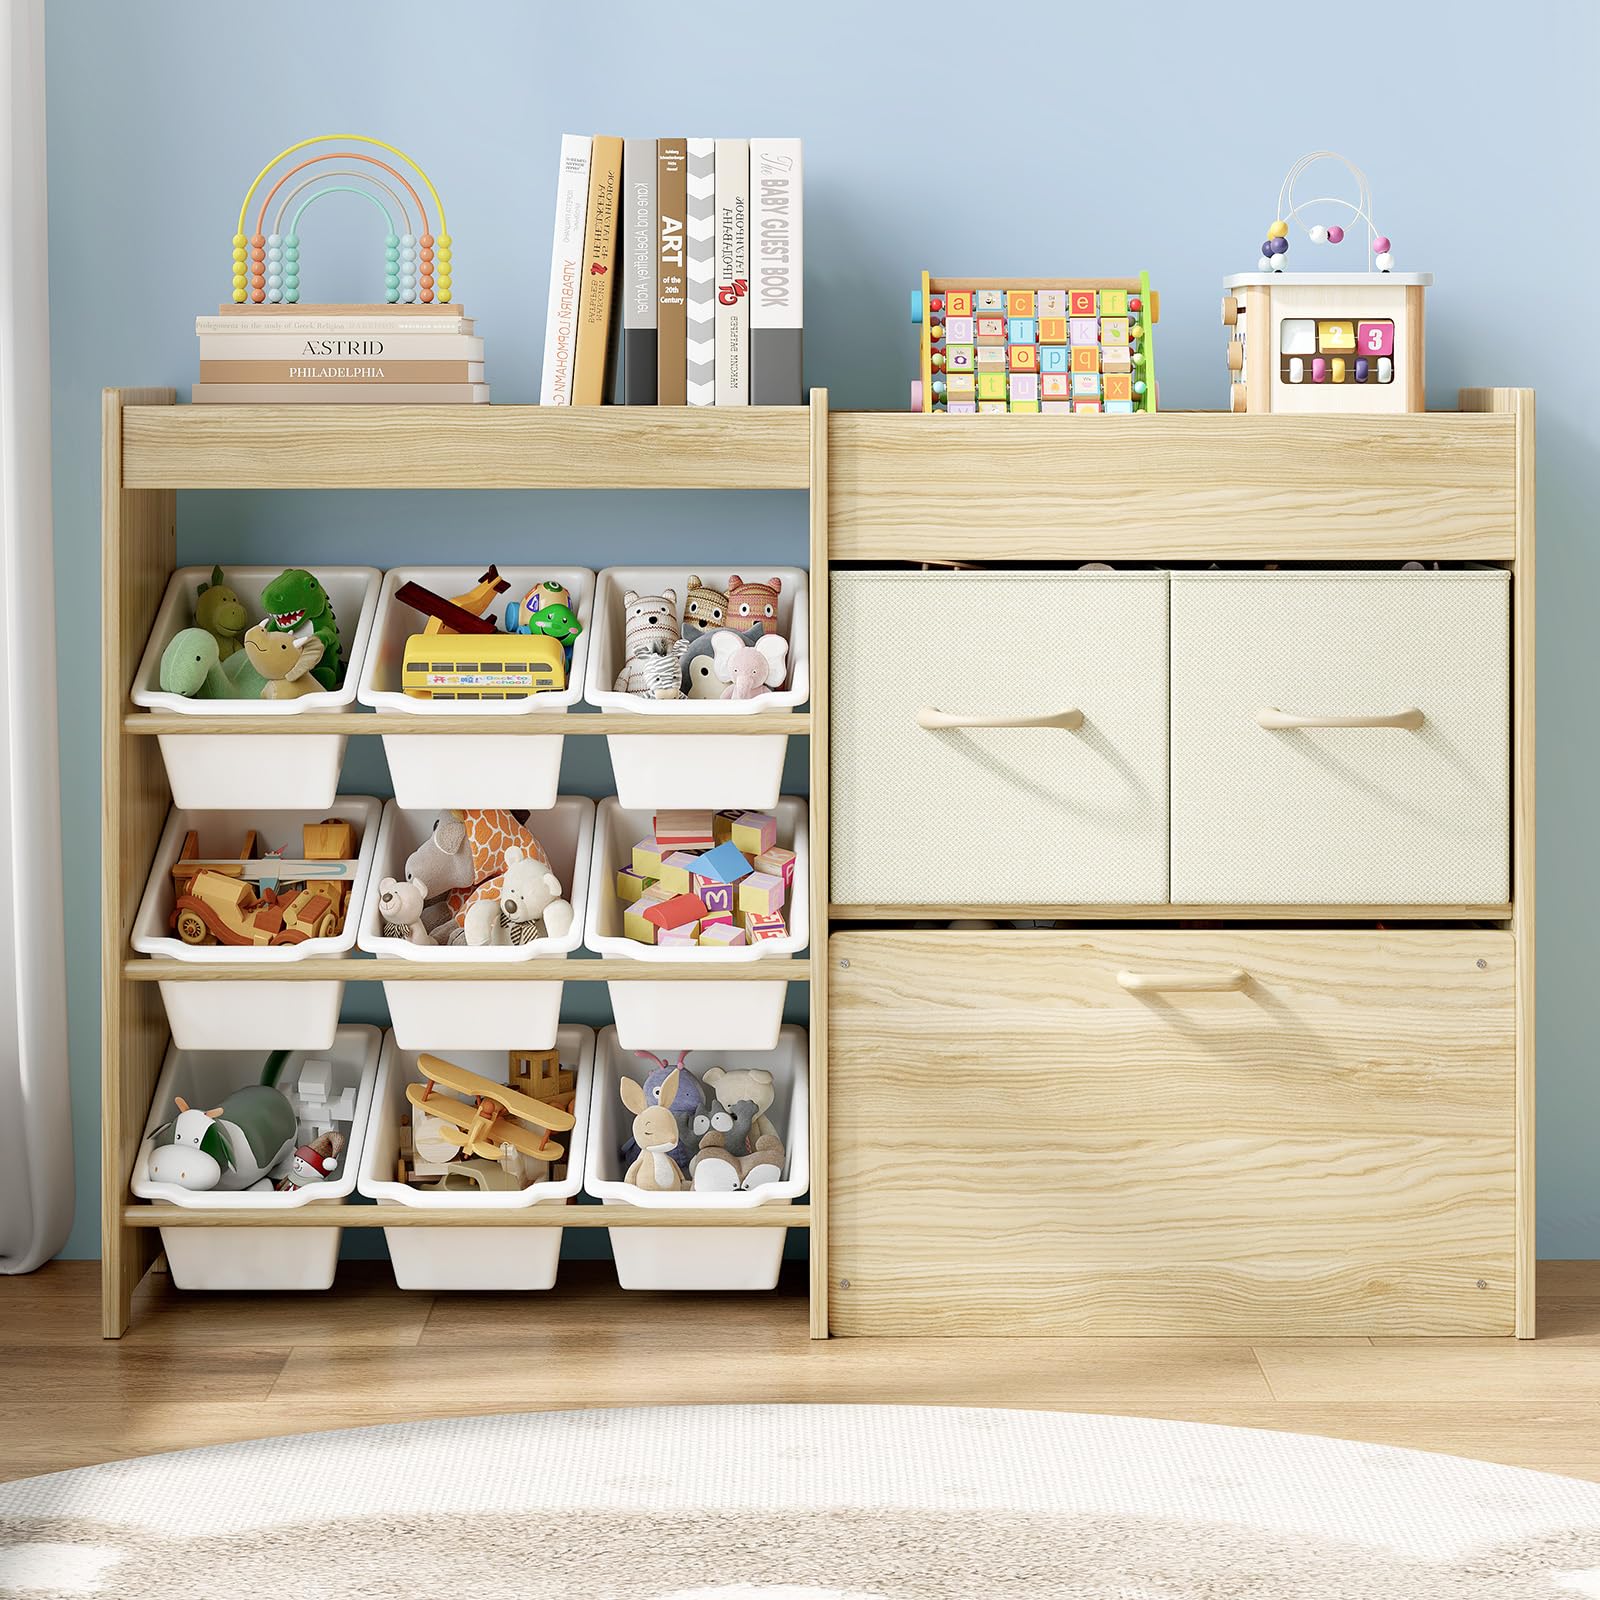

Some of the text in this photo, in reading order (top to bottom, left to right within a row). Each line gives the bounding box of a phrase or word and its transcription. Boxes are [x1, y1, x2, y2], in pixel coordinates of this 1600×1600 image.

[760, 153, 794, 307] The BABY GUEST BOOK
[661, 215, 683, 268] ART
[663, 276, 682, 284] of the
[664, 286, 679, 294] 20th
[659, 296, 684, 305] Century
[953, 297, 965, 310] a
[1015, 298, 1026, 310] c
[1076, 295, 1089, 308] e
[954, 321, 966, 338] g
[1079, 321, 1089, 339] k
[1328, 326, 1343, 345] 2
[1368, 328, 1383, 351] 3
[1017, 350, 1028, 362] o
[1049, 350, 1061, 368] p
[1079, 351, 1091, 368] q
[289, 367, 385, 378] PHILADELPHIA
[1017, 380, 1029, 394] u
[1113, 380, 1123, 395] x
[706, 890, 726, 910] M
